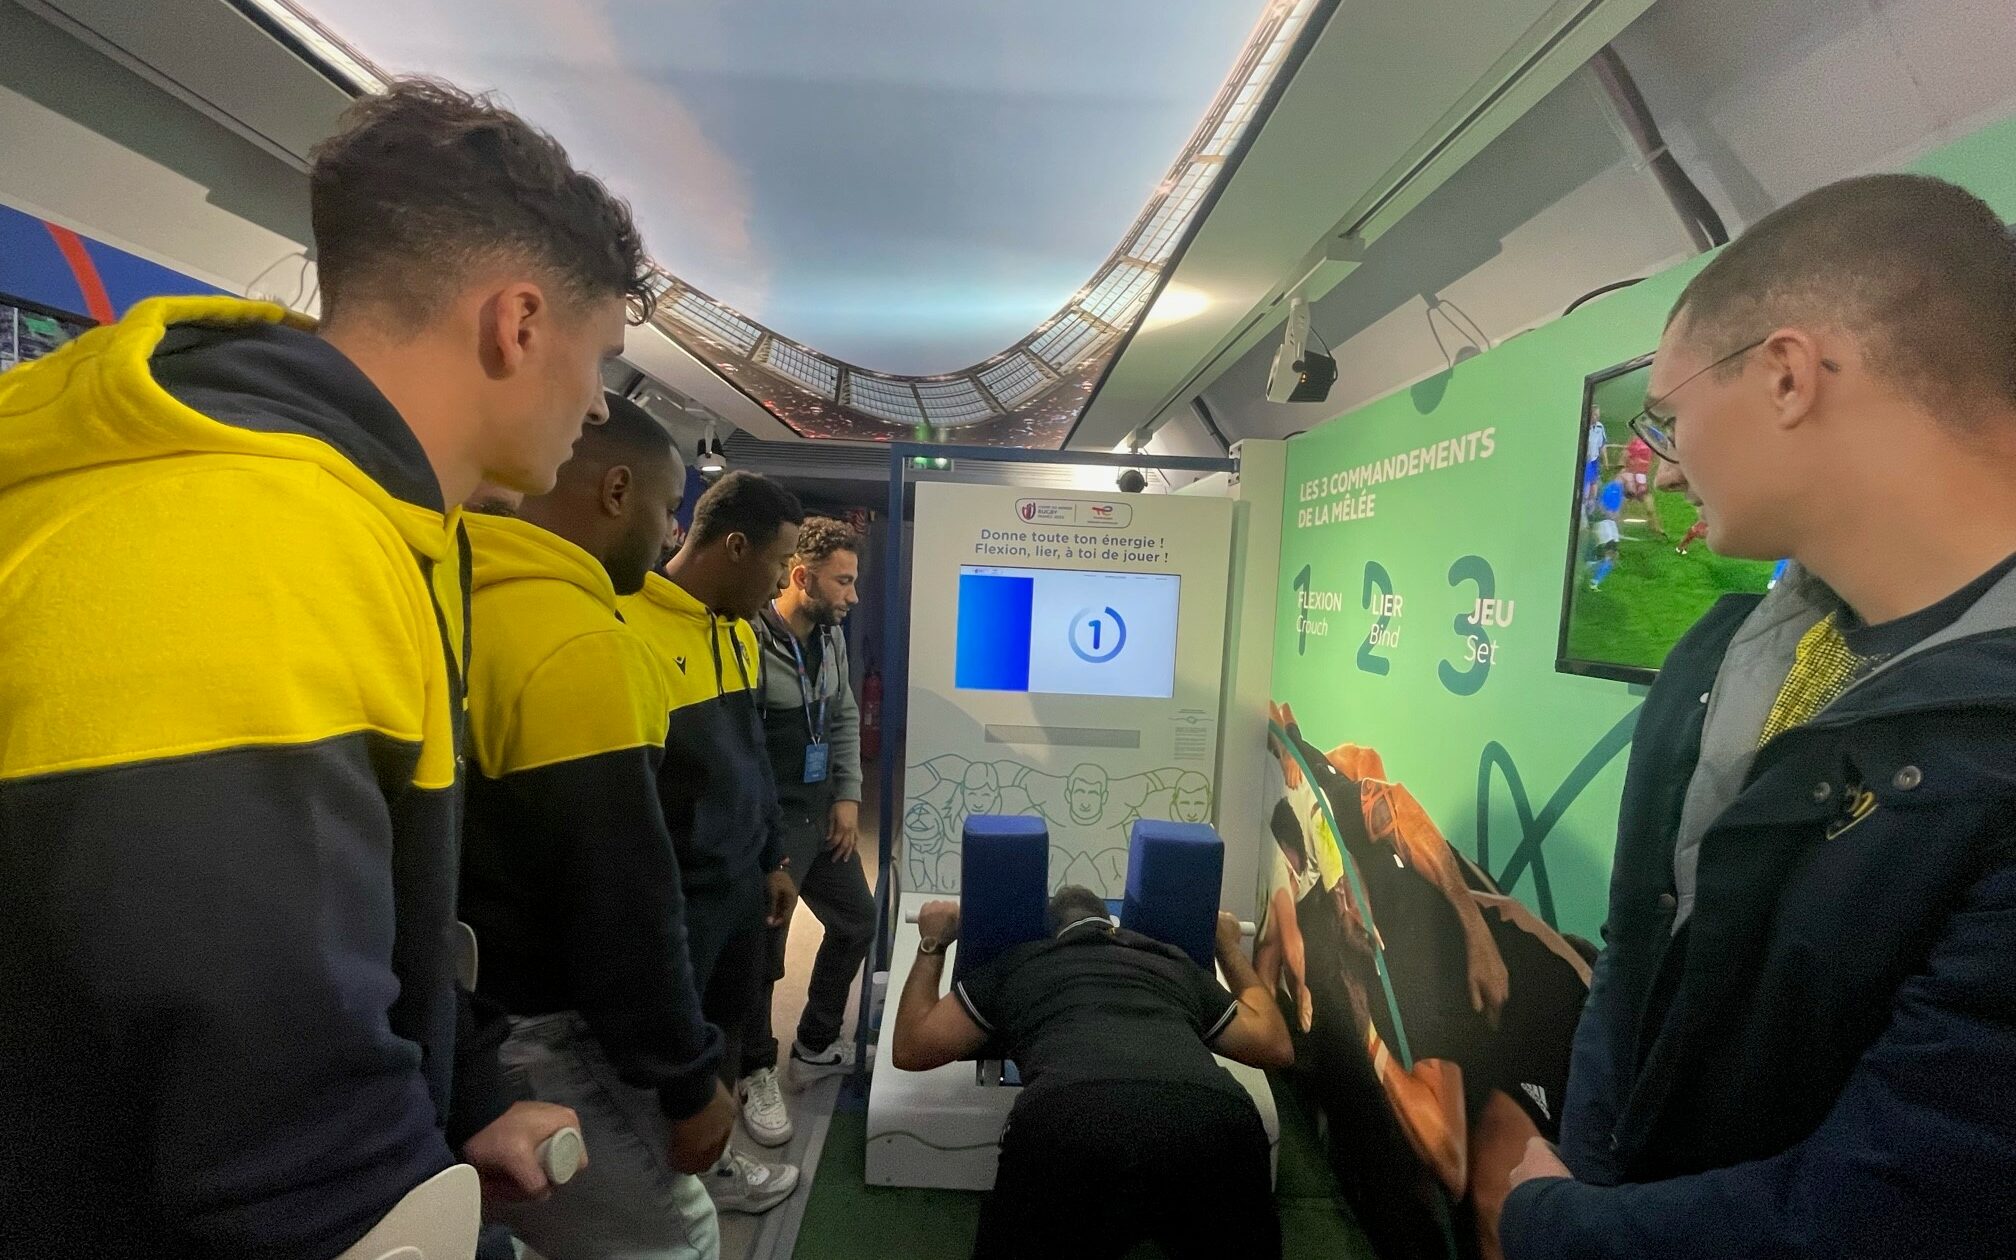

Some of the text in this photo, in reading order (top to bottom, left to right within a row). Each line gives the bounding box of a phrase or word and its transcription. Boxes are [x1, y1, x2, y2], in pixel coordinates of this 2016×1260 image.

[1300, 427, 1496, 502] LES 3 COMMANDEMENTS
[1298, 488, 1376, 529] DE LA MÊLÉE
[975, 543, 1030, 557] Flexion,
[1036, 545, 1060, 559] lier,
[1065, 546, 1073, 558] à
[1078, 548, 1096, 559] toi
[1101, 549, 1119, 560] de
[1123, 550, 1160, 563] jouer
[981, 529, 1027, 541] Donne
[1032, 531, 1069, 543] toute
[1074, 534, 1097, 545] ton
[1102, 534, 1155, 549] énergie
[1293, 564, 1311, 656] 1
[1298, 591, 1342, 611] FLEXION
[1372, 594, 1403, 617] LIER
[1467, 598, 1515, 628] JEU
[1296, 614, 1328, 636] Crouch
[1356, 560, 1393, 676] 2
[1438, 555, 1495, 696] 3
[1088, 619, 1101, 650] 1
[1369, 624, 1400, 648] Bind
[1463, 634, 1499, 665] Set
